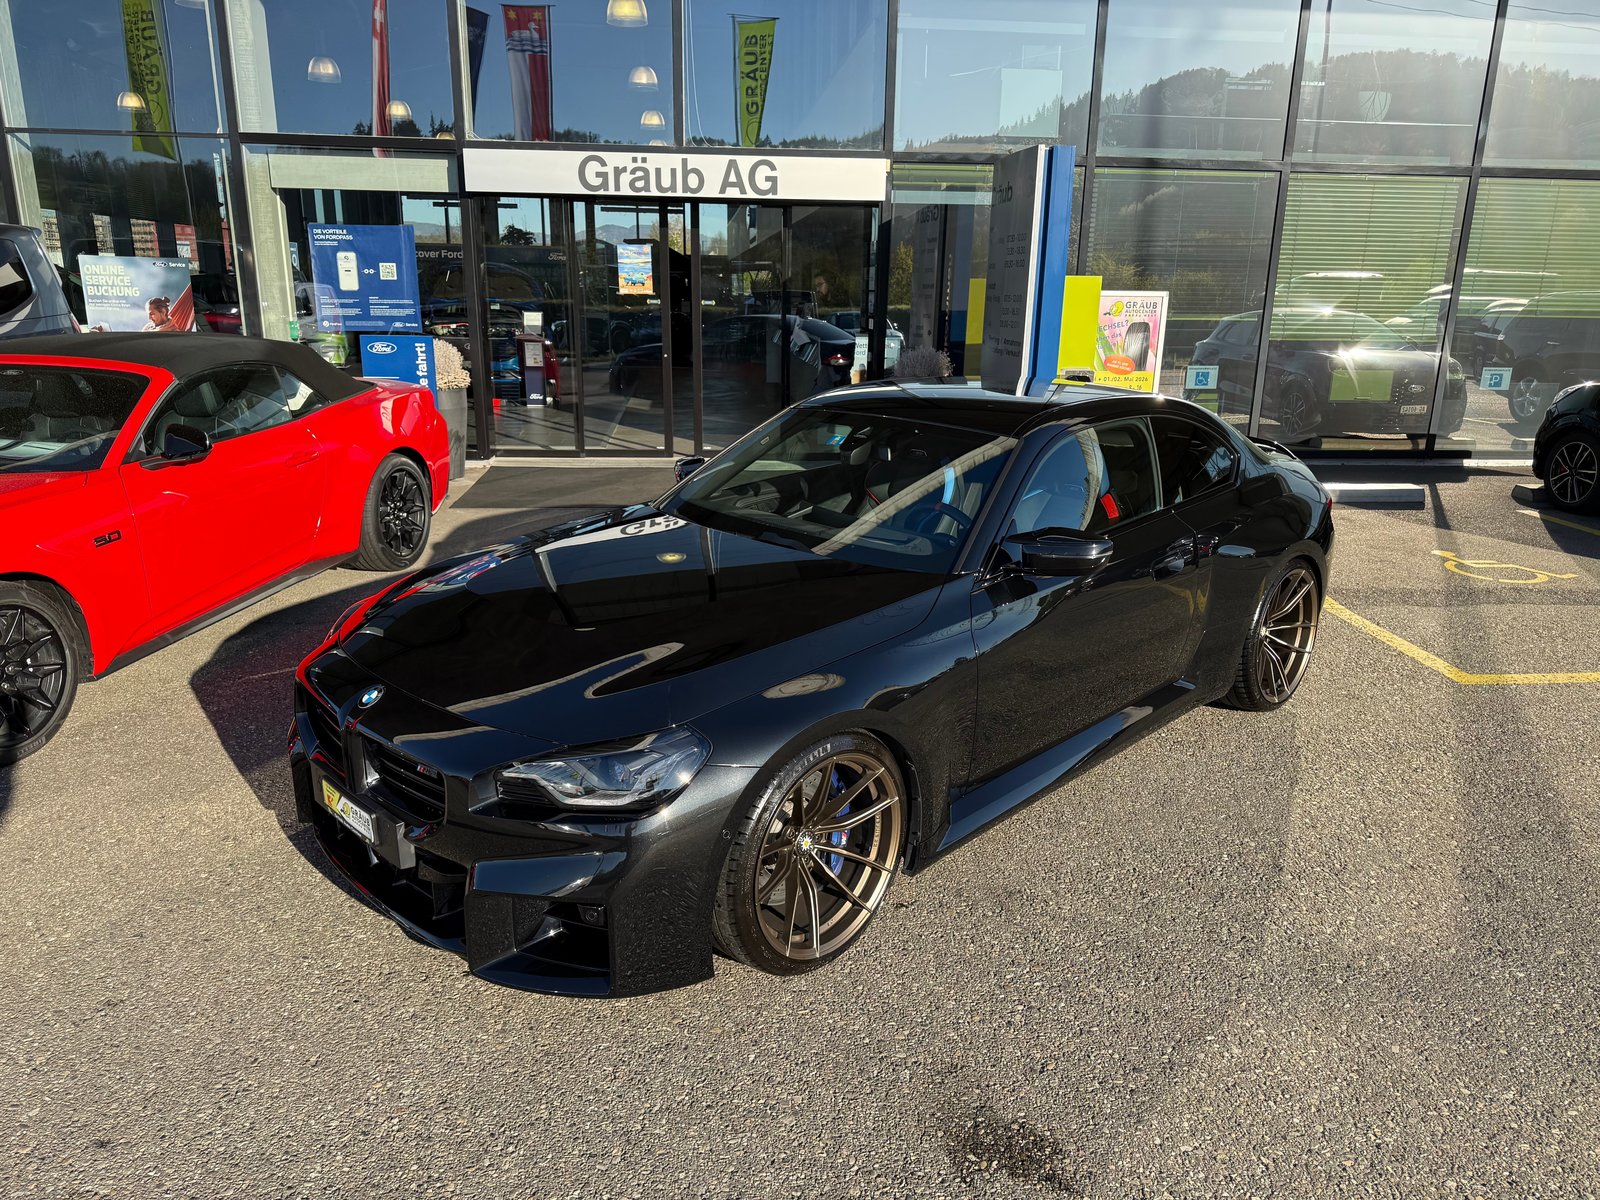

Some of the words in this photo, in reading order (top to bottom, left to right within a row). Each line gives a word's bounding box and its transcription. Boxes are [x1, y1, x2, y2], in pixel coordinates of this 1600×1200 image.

[741, 34, 759, 116] GRÄUB
[577, 154, 705, 194] Gräub
[718, 158, 778, 196] AG
[416, 250, 440, 258] cover
[84, 264, 125, 275] ONLINE
[86, 275, 131, 286] SERVICE
[87, 285, 140, 297] BUCHUNG
[1125, 300, 1158, 309] GRÄUB
[1098, 319, 1129, 331] ECHSEL?
[369, 343, 395, 353] Ford
[414, 342, 429, 376] fahrt!
